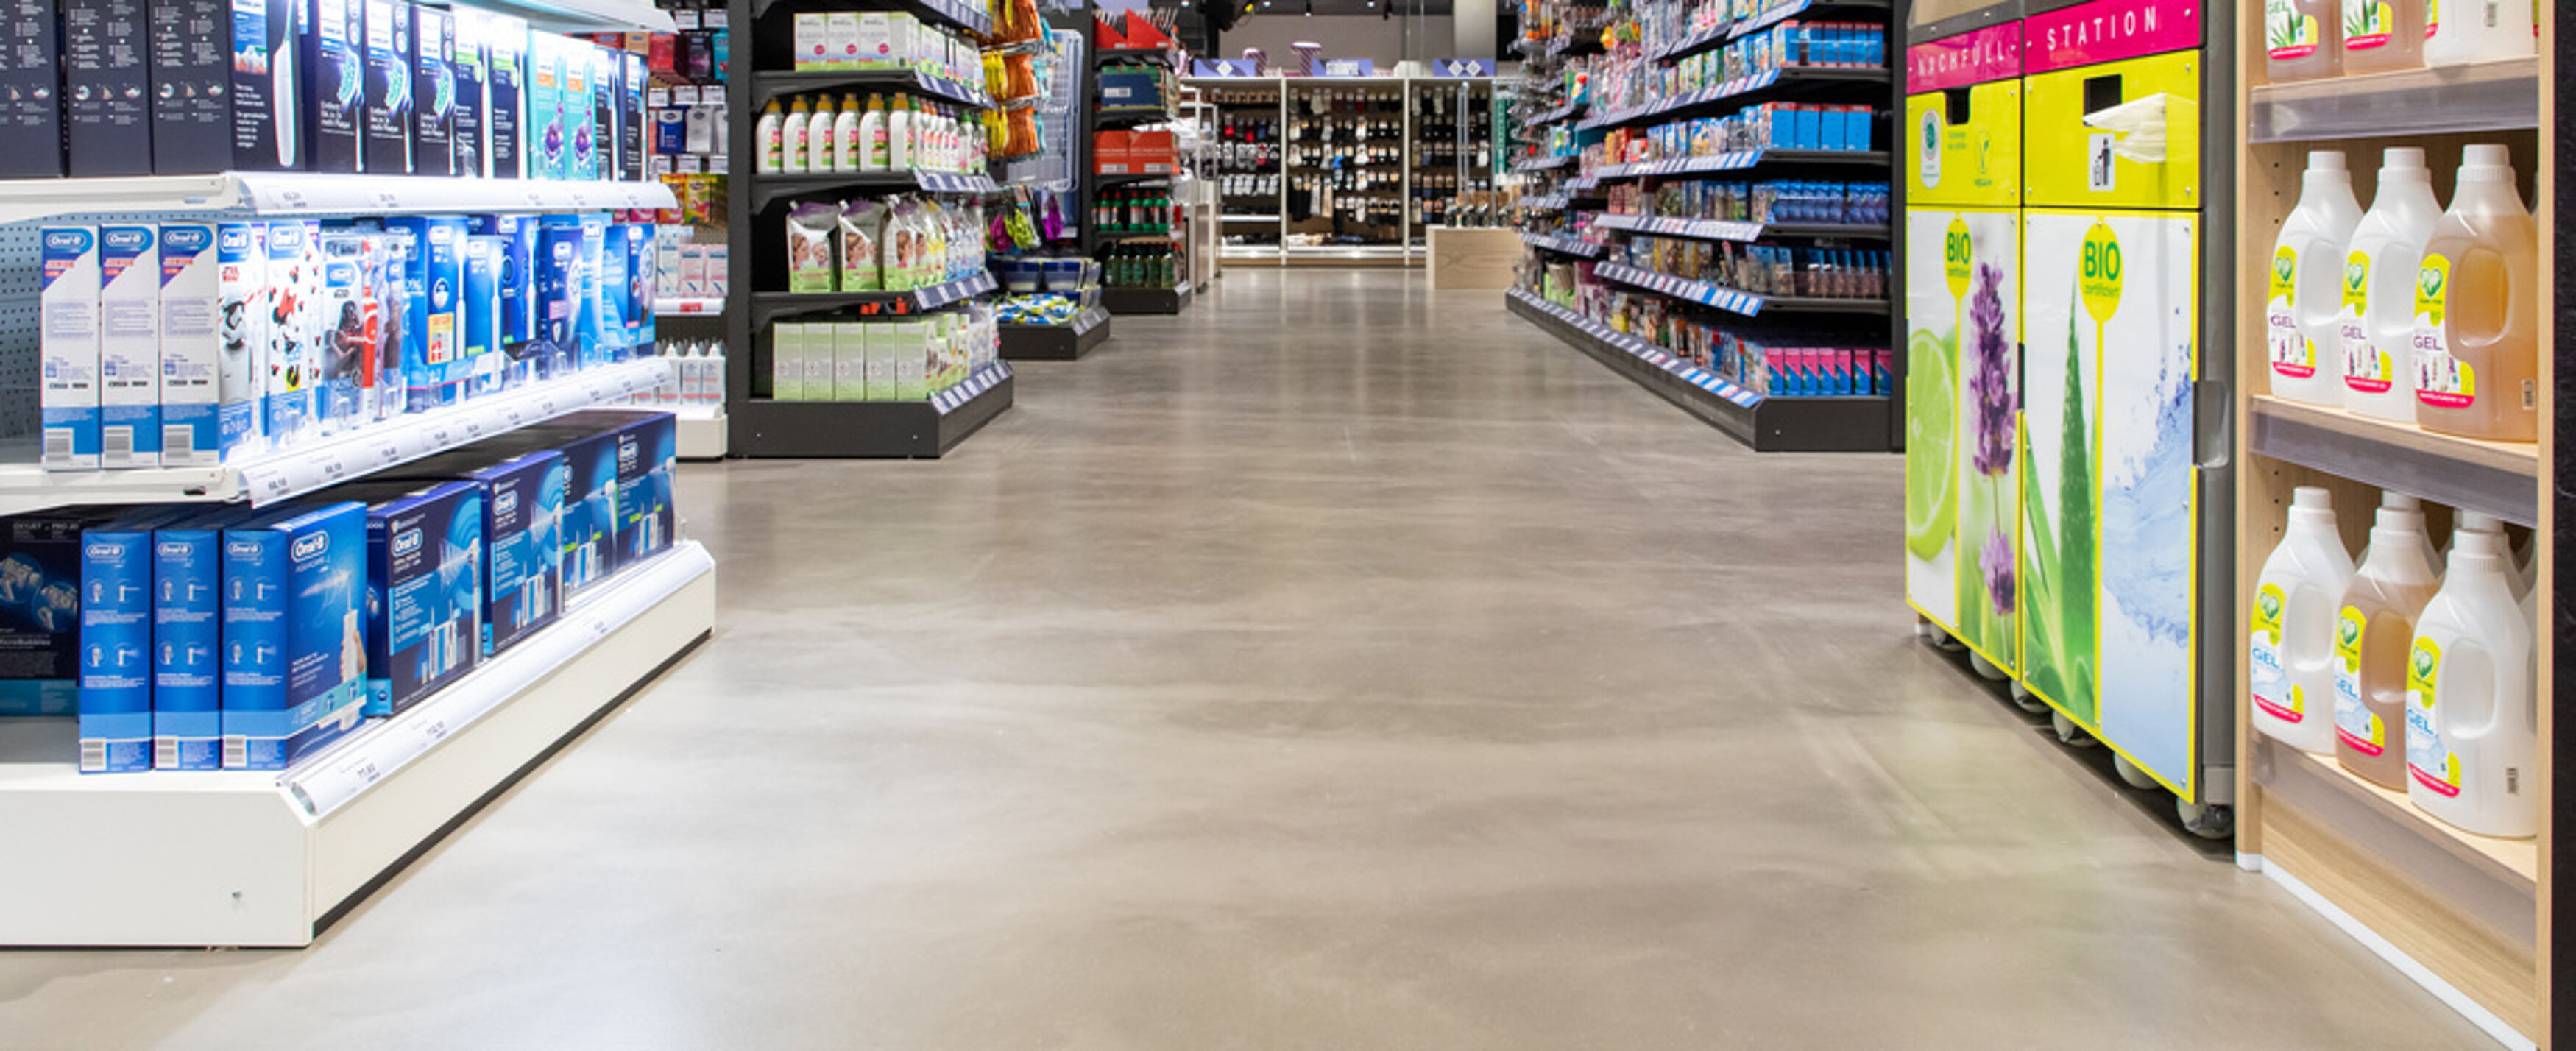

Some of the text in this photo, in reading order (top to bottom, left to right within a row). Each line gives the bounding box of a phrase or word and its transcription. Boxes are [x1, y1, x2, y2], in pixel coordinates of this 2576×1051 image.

[2047, 7, 2157, 51] STATION
[52, 236, 81, 245] Oral-B
[111, 235, 141, 244] Oral-B
[169, 234, 199, 243] Oral-B
[1947, 233, 1971, 264] BIO
[2084, 241, 2120, 280] BIO
[2271, 316, 2296, 328] GEL
[2340, 325, 2366, 339] GEL
[2413, 336, 2443, 350] GEL
[295, 536, 324, 556] Oral-B
[2252, 648, 2279, 670] GEL
